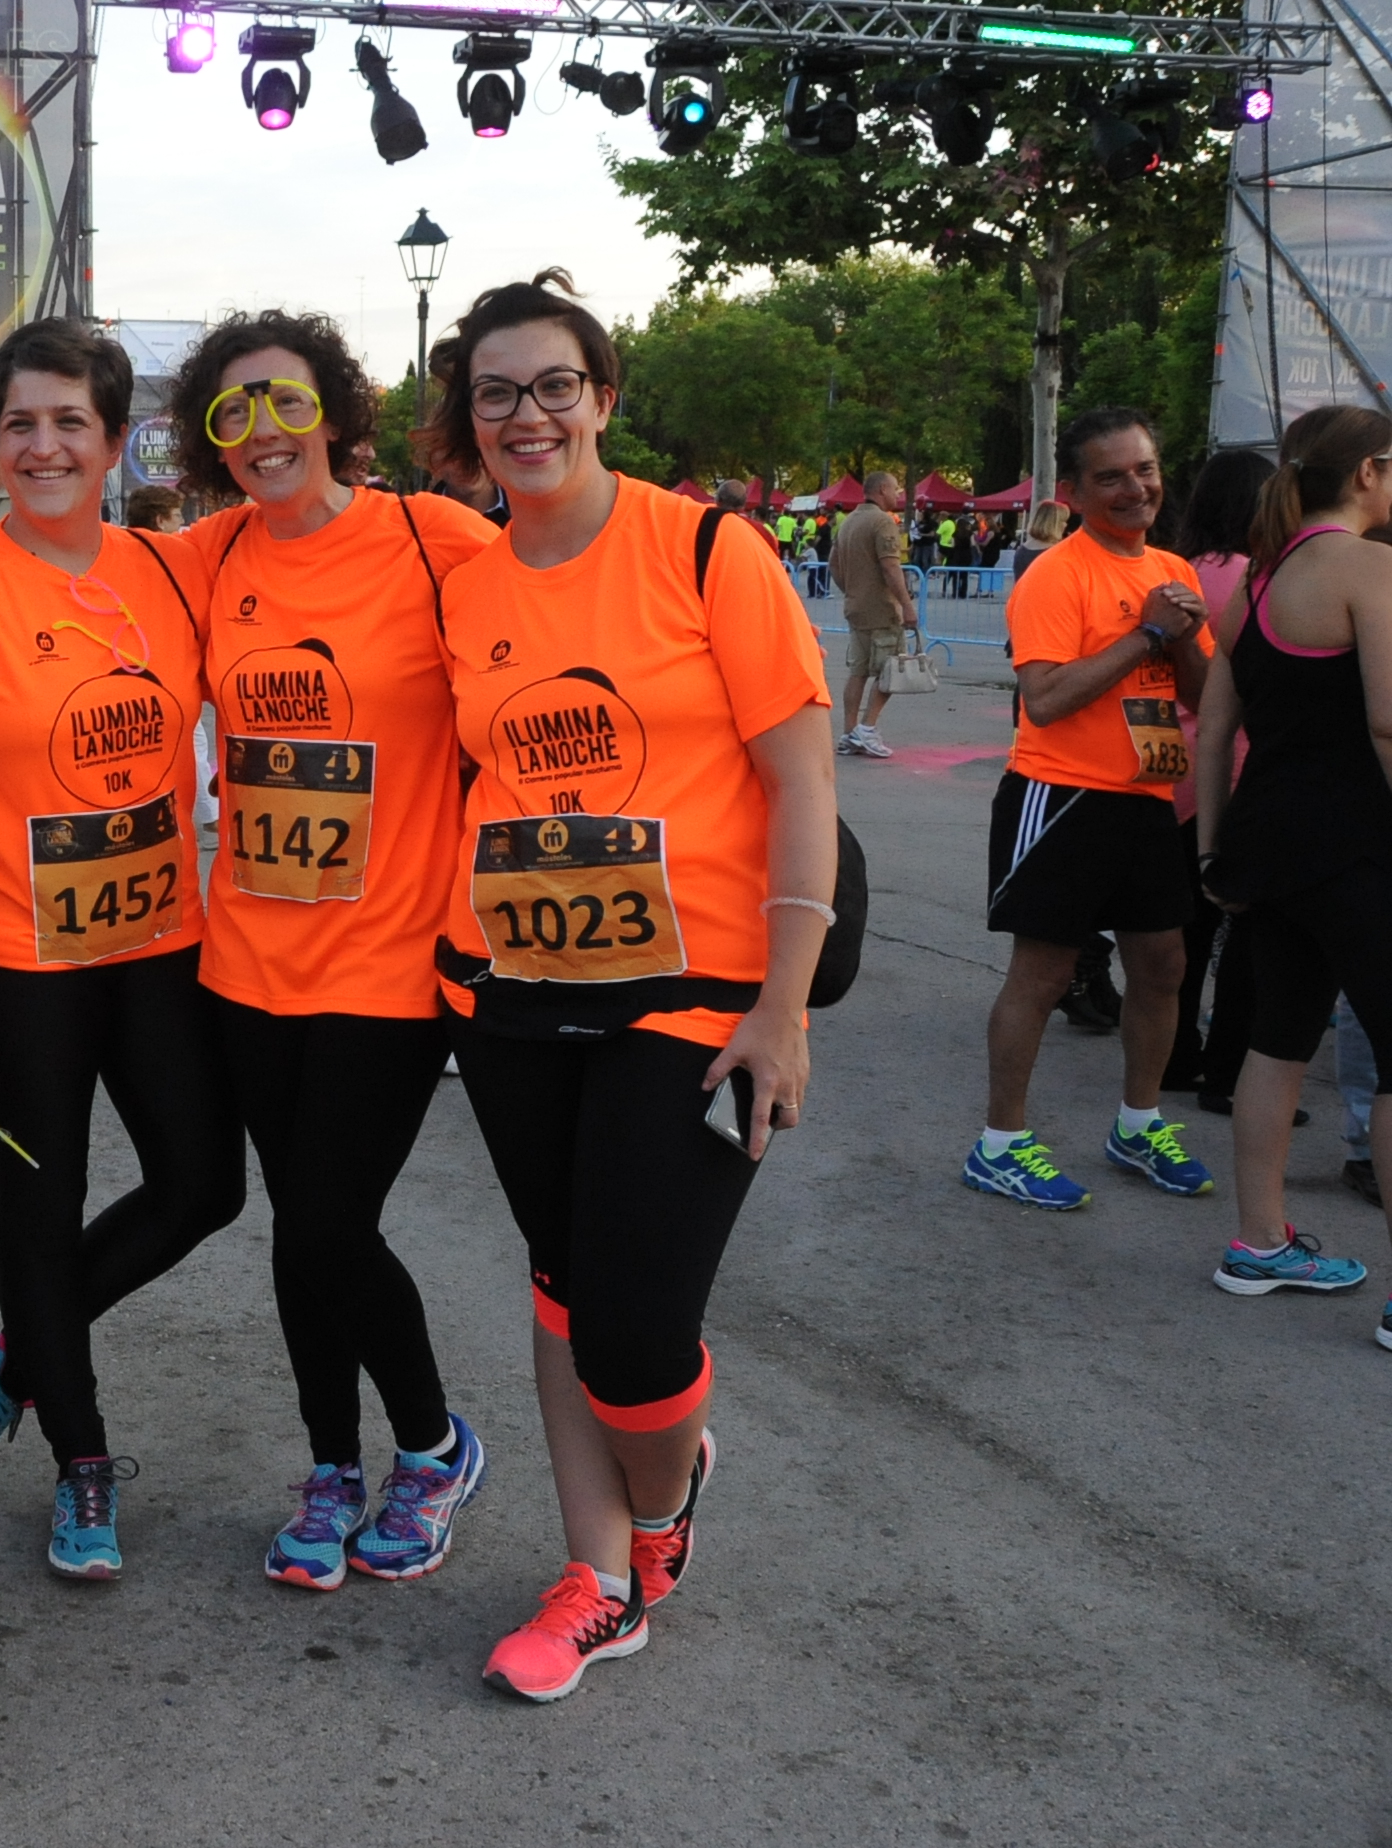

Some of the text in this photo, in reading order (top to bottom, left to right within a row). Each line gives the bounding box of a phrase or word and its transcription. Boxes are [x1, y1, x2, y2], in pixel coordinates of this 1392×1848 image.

[236, 670, 327, 700] ILUMINA
[70, 695, 164, 738] ILUMINA
[502, 704, 615, 748] ILUMINA
[103, 769, 133, 794] 10K
[549, 789, 586, 815] 10K
[233, 809, 350, 870] 1142
[54, 862, 177, 935] 1452
[494, 890, 657, 952] 1023
